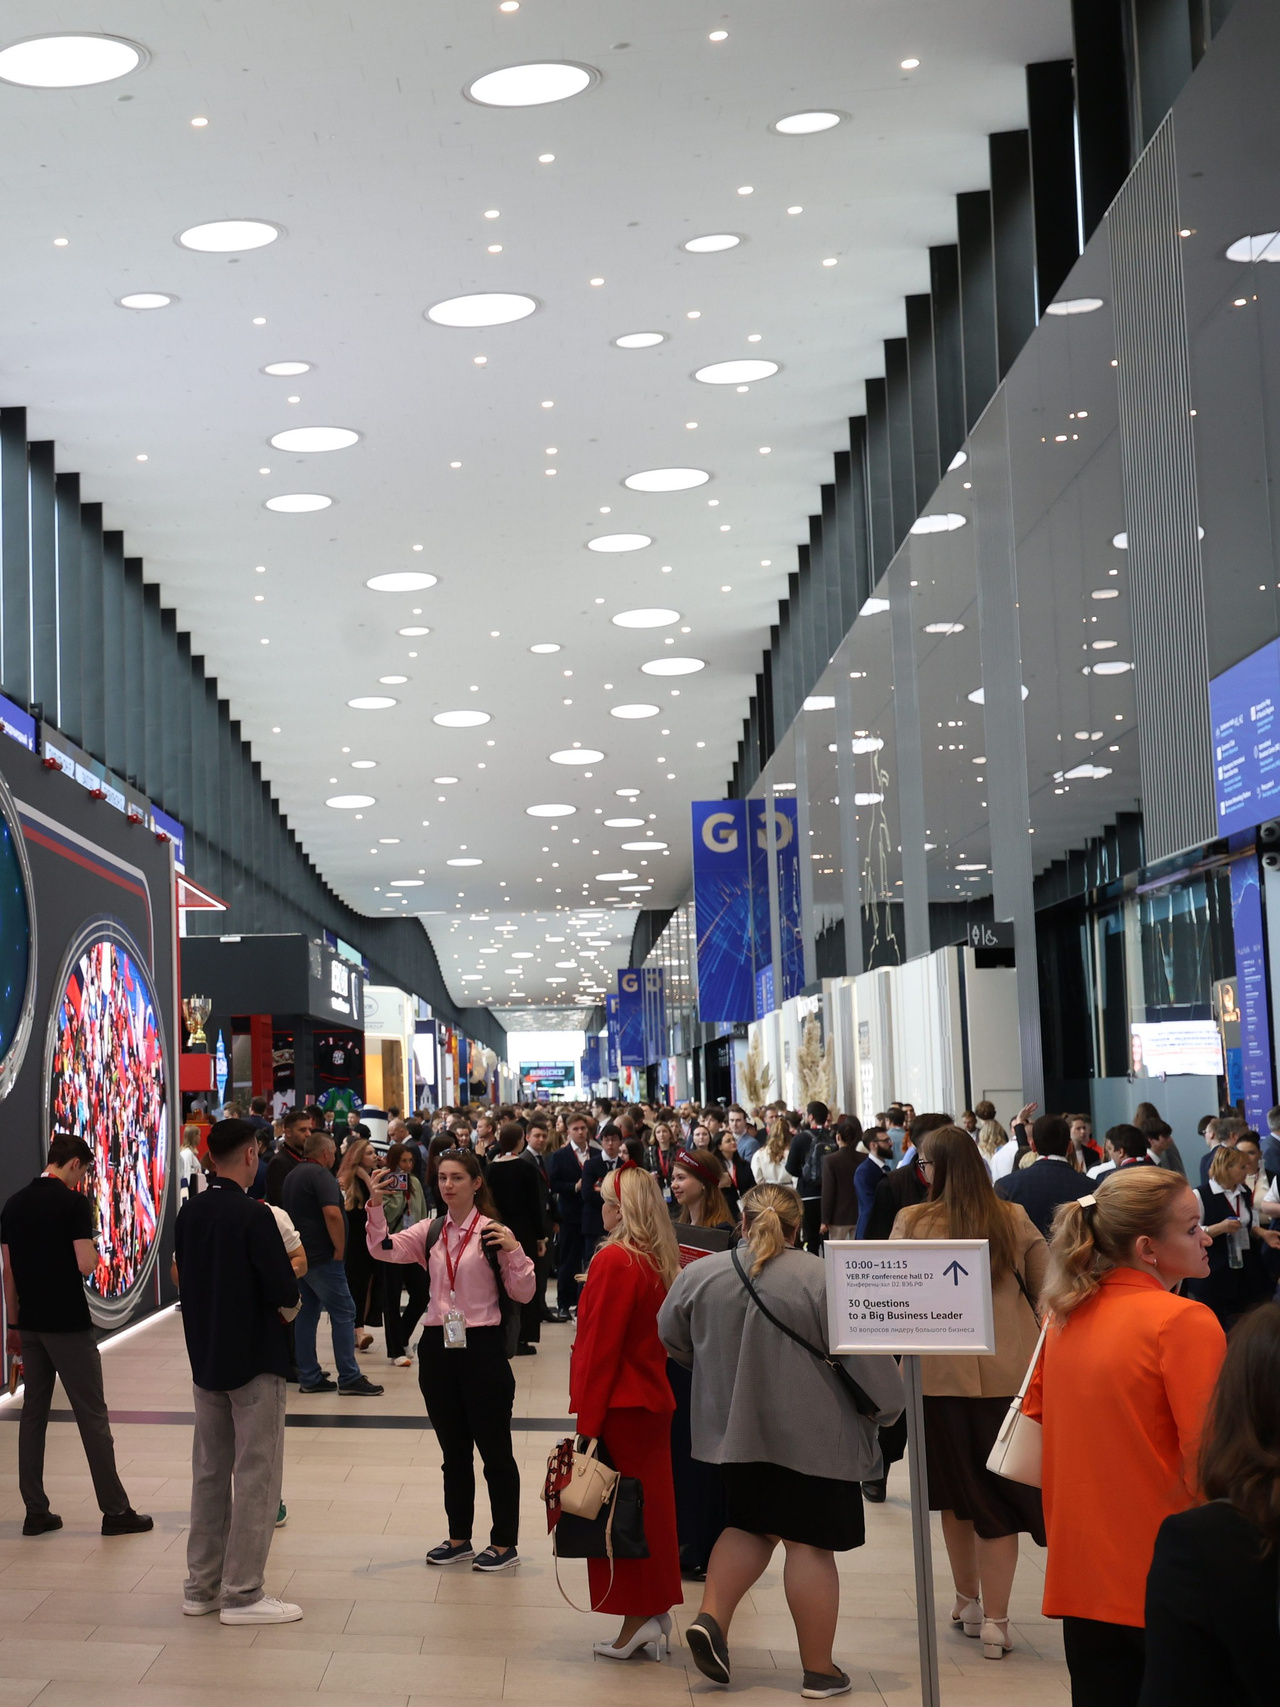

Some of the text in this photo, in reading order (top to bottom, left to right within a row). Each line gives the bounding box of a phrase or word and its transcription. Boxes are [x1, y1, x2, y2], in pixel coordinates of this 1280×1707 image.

[701, 812, 738, 853] G
[622, 973, 638, 993] G
[848, 1299, 910, 1310] 30 Questions
[848, 1312, 858, 1320] to
[869, 1311, 885, 1322] Big
[887, 1311, 928, 1320] Business
[931, 1311, 963, 1320] Leader
